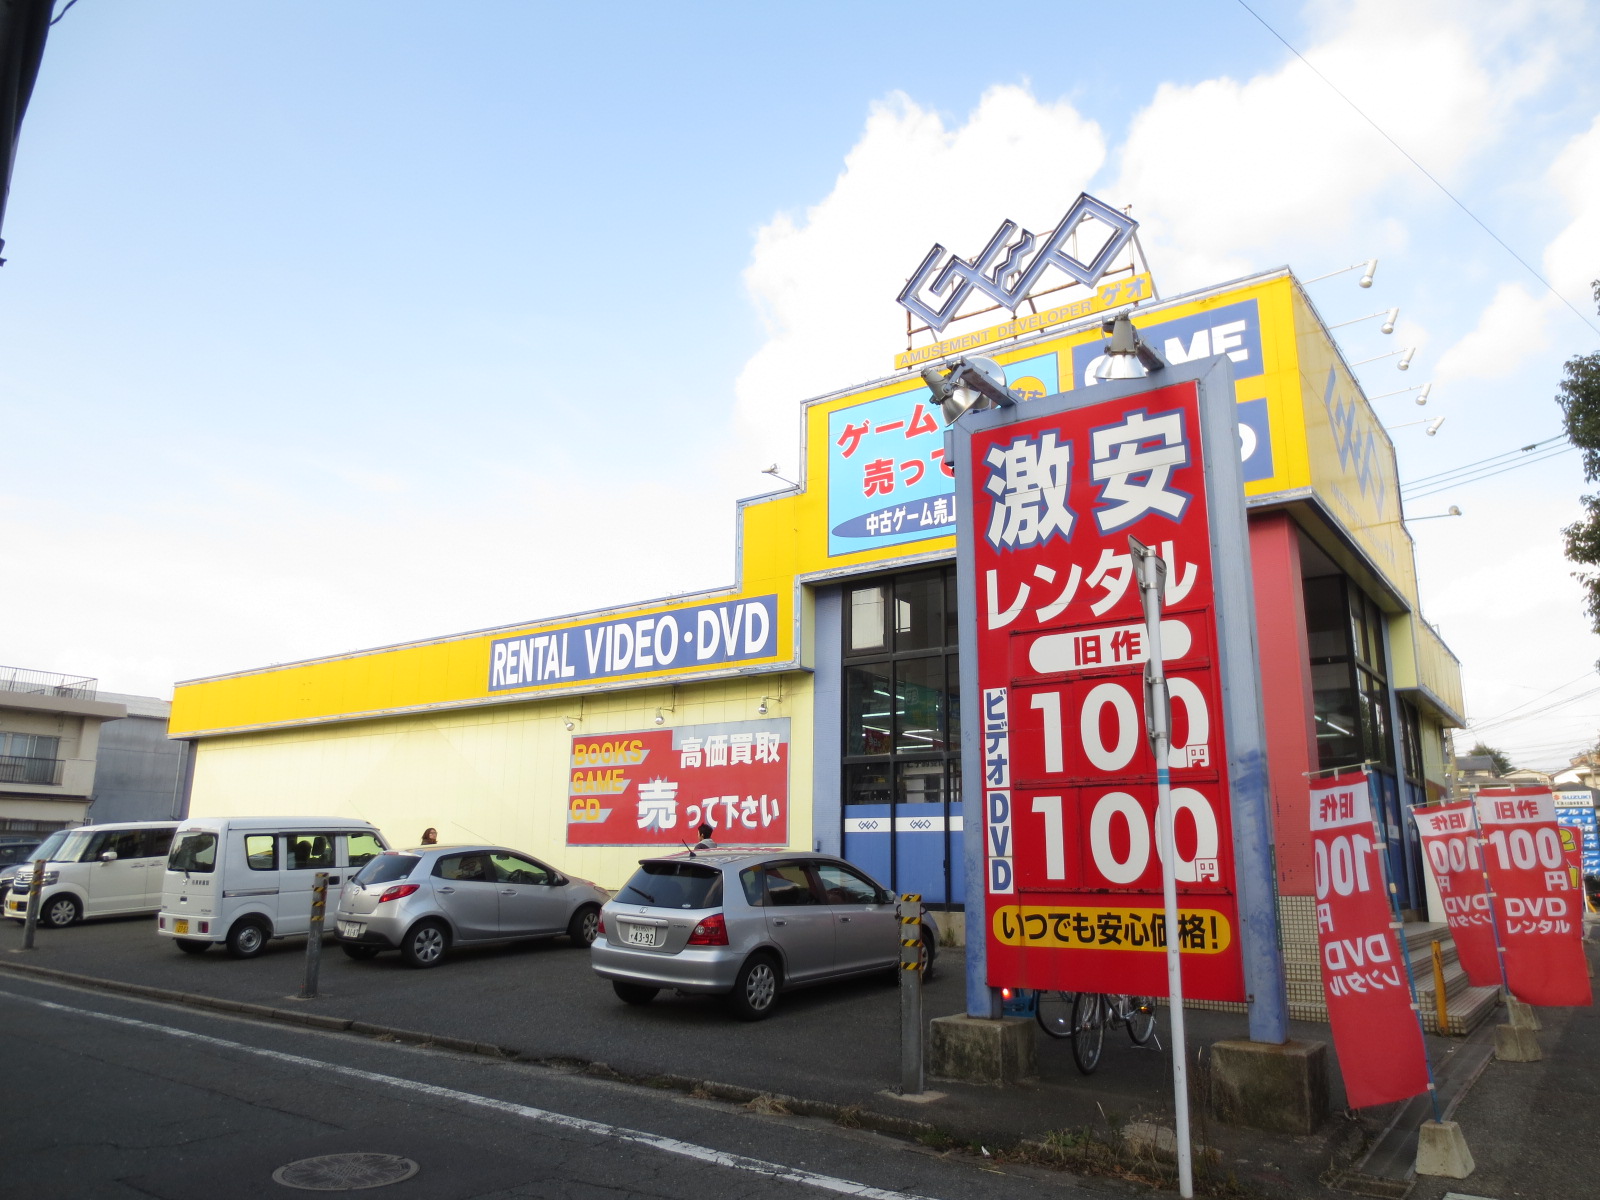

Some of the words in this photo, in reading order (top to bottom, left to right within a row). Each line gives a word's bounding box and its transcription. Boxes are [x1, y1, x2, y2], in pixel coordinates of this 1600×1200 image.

[900, 330, 990, 366] AMUSEMENT
[998, 300, 1092, 338] DEVELOPER
[1101, 277, 1146, 306] ゲオ
[836, 403, 939, 459] ゲーム
[985, 410, 1191, 552] 激安
[986, 540, 1198, 631] レンタル
[492, 632, 575, 687] RENTAL
[1073, 630, 1142, 666] 旧作
[573, 739, 644, 766] BOOKS
[680, 732, 781, 769] 高価買取
[984, 688, 1008, 786] ビデオ
[572, 769, 626, 793] GAME
[571, 798, 601, 821] CD
[1494, 799, 1539, 820] 旧作
[989, 793, 1012, 891] DVD
[1489, 827, 1562, 870] 100
[1544, 871, 1569, 892] 円
[1504, 897, 1567, 917] DVD
[1506, 919, 1571, 934] レンタル
